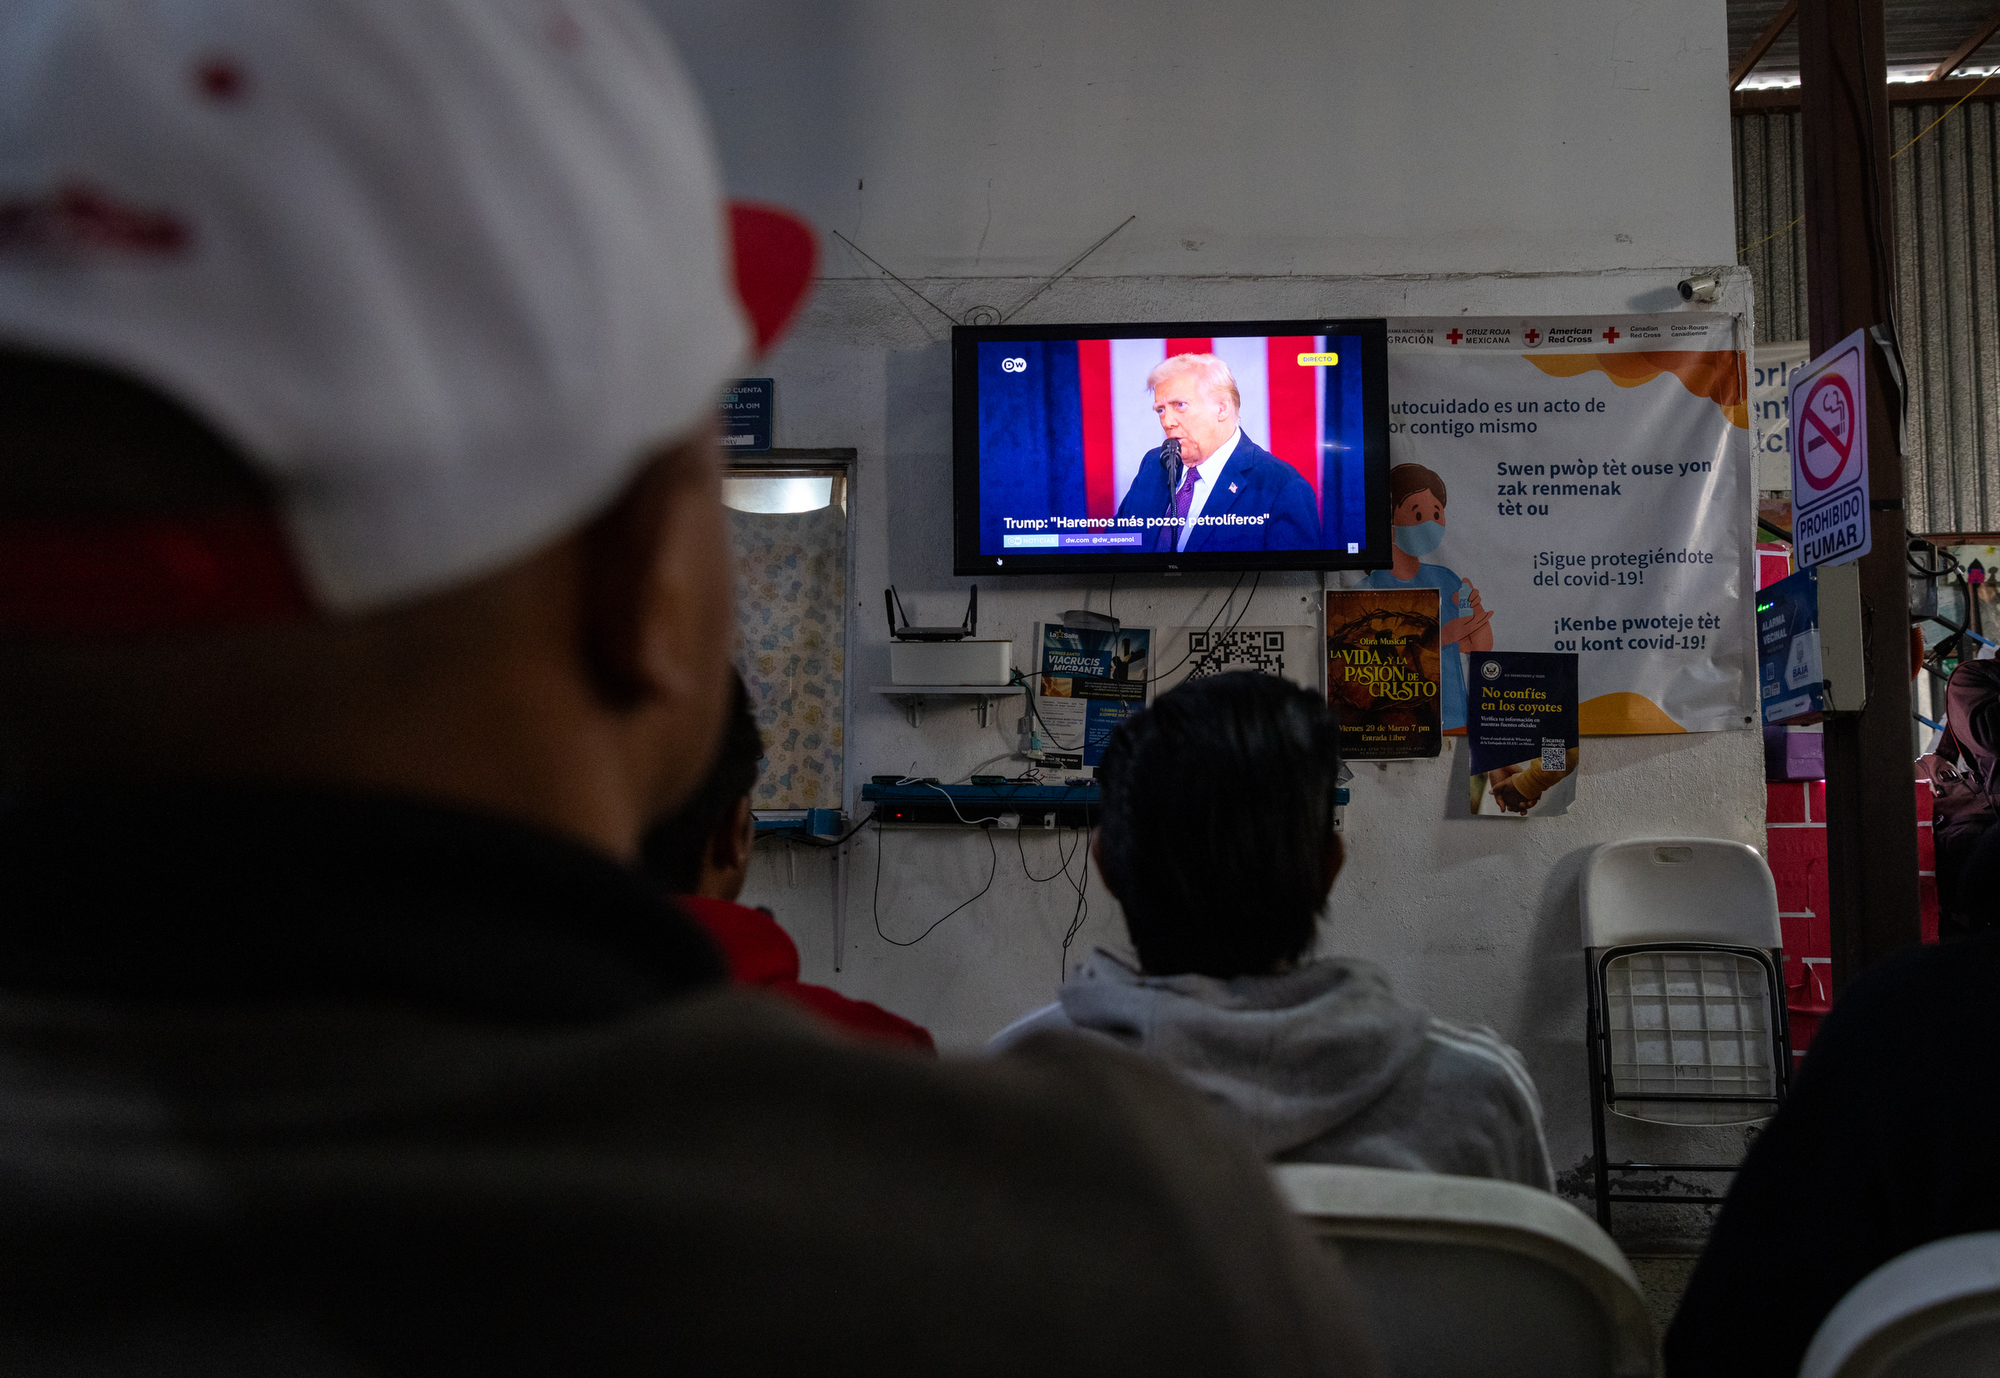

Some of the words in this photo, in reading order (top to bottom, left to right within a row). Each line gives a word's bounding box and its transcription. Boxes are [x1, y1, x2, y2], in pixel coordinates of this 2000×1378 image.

[1387, 334, 1433, 344] GRACIÓN
[1548, 327, 1592, 335] American
[1003, 358, 1027, 372] DW
[1391, 398, 1489, 415] utocuidado
[1494, 401, 1512, 413] es
[1517, 401, 1538, 413] un
[1543, 399, 1580, 413] acto
[1584, 398, 1606, 413] de
[1389, 422, 1405, 434] or
[1410, 418, 1474, 438] contigo
[1480, 418, 1537, 433] mismo
[1497, 461, 1545, 476] Swen
[1550, 458, 1598, 478] pwòp
[1602, 458, 1627, 476] tèt
[1631, 462, 1673, 476] ouse
[1678, 460, 1712, 477] yon
[1497, 481, 1528, 496] zak
[1532, 481, 1622, 496] renmenak
[1497, 499, 1523, 516] tèt
[1527, 503, 1548, 516] ou
[1003, 516, 1048, 531] Trump:
[1050, 515, 1115, 529] "Haremos
[1117, 514, 1144, 528] más
[1147, 516, 1185, 530] pozos
[1189, 513, 1270, 530] petrolíferos"
[1800, 495, 1859, 540] PROHIBIDO
[1092, 536, 1135, 545] @dw_espanol
[1803, 523, 1857, 563] FUMAR
[1533, 551, 1586, 570] ¡Sigue
[1591, 548, 1713, 570] protegiéndote
[1533, 571, 1559, 586] del
[1563, 570, 1644, 586] covid-19!
[1554, 616, 1617, 635] ¡Kenbe
[1622, 613, 1694, 633] pwoteje
[1697, 612, 1721, 630] tèt
[1762, 614, 1786, 632] ALARMA
[1360, 637, 1378, 646] Obra
[1380, 637, 1407, 646] Musical
[1554, 639, 1576, 651] ou
[1581, 636, 1623, 651] kont
[1628, 633, 1706, 650] covid-19!
[1763, 628, 1788, 645] VECINAL
[1049, 655, 1100, 666] VIACRUCIS
[1330, 650, 1342, 659] LA
[1342, 649, 1382, 665] VIDA
[1387, 656, 1394, 665] Y
[1396, 656, 1408, 665] LA
[1053, 664, 1105, 675] MIGRANTE
[1345, 661, 1405, 685] PASIÓN
[1407, 672, 1419, 682] DE
[1793, 664, 1808, 678] BAJA
[1369, 681, 1437, 701] CRISTO
[1482, 686, 1501, 699] No
[1503, 687, 1547, 700] confíes
[1481, 702, 1496, 711] en
[1499, 699, 1516, 712] los
[1518, 703, 1563, 716] coyotes
[1338, 724, 1364, 732] Viernes
[1366, 724, 1375, 732] 29
[1377, 724, 1386, 732] de
[1388, 724, 1409, 732] Marzo
[1418, 725, 1430, 733] pm
[1362, 734, 1388, 742] Entrada
[1389, 734, 1407, 742] Libre
